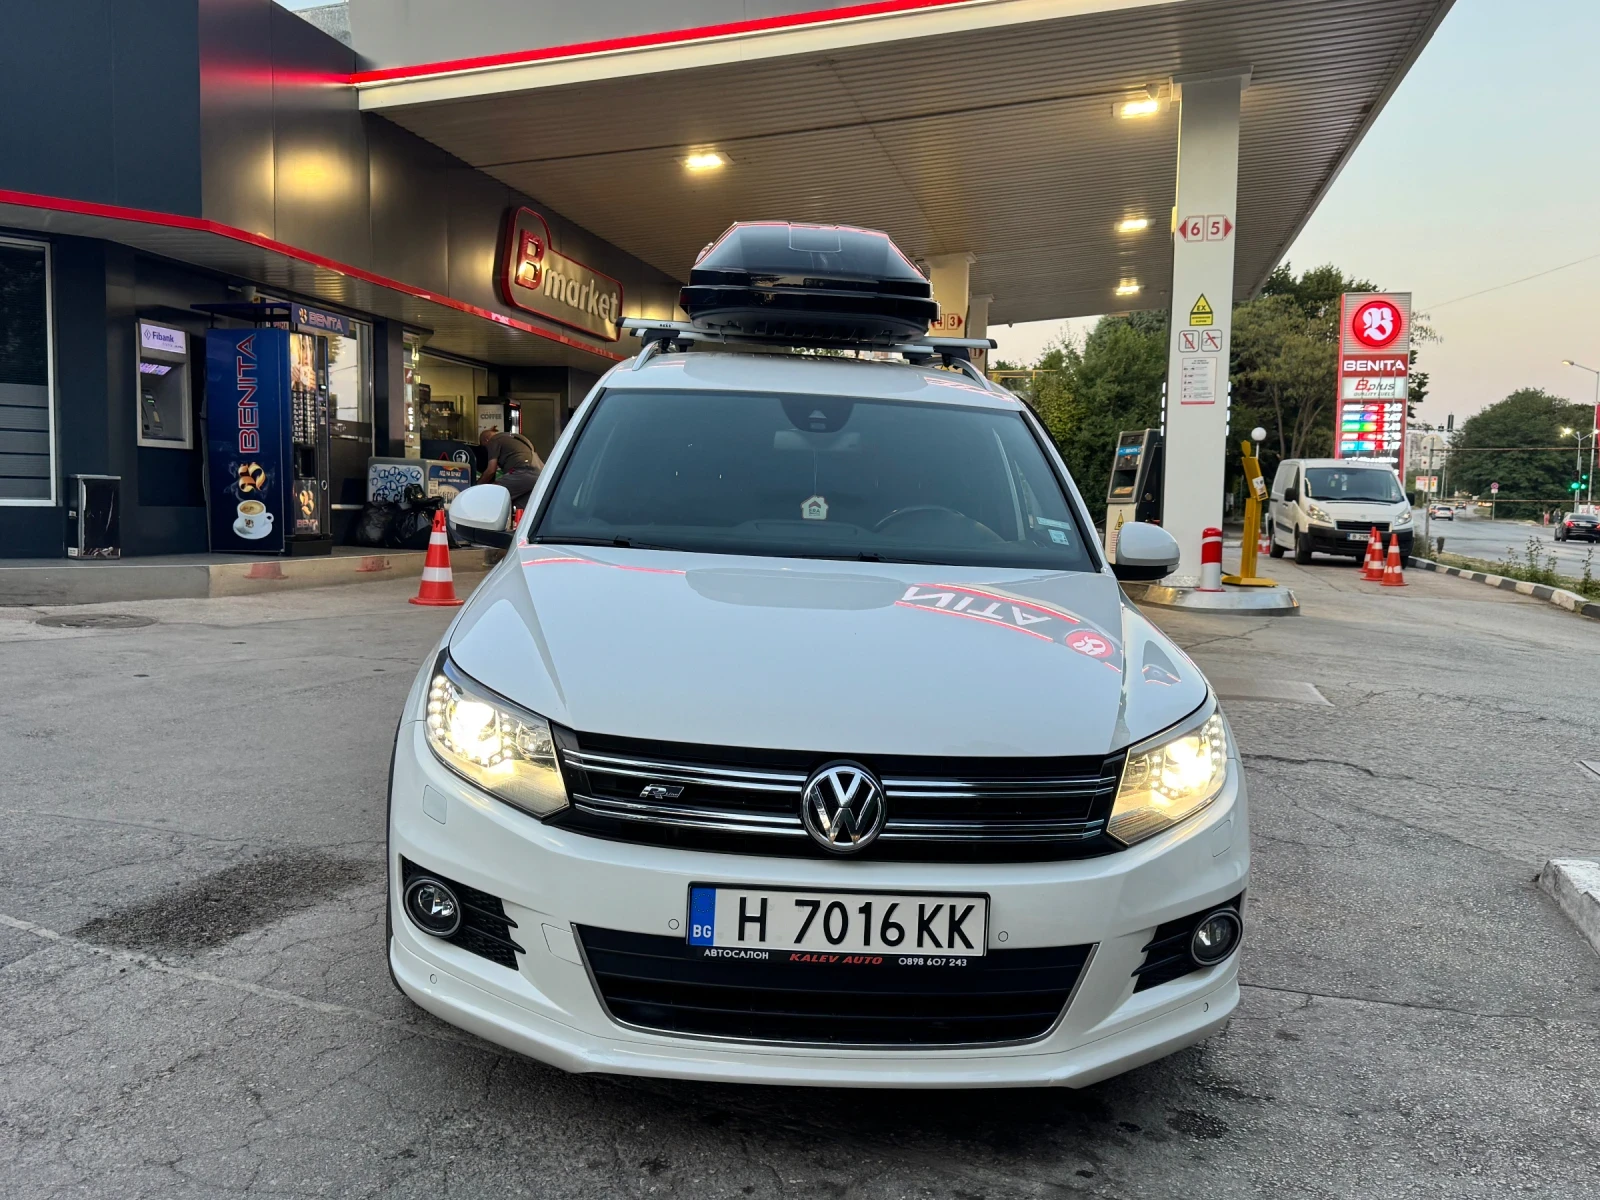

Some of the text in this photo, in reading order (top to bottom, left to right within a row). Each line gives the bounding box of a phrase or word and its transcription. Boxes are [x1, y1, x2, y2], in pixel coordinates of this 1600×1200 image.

[1190, 221, 1221, 237] 6 5
[309, 311, 344, 332] BENITA
[950, 316, 956, 327] 3
[152, 331, 175, 343] Fibank
[1343, 360, 1406, 372] BENITA
[236, 334, 260, 453] BENITA
[736, 896, 976, 950] H 7016 KK
[692, 924, 713, 939] BG
[703, 948, 770, 961] АВТОСАЛОН
[789, 953, 884, 966] KALEV AUTO
[898, 957, 968, 968] 0898 607 243
